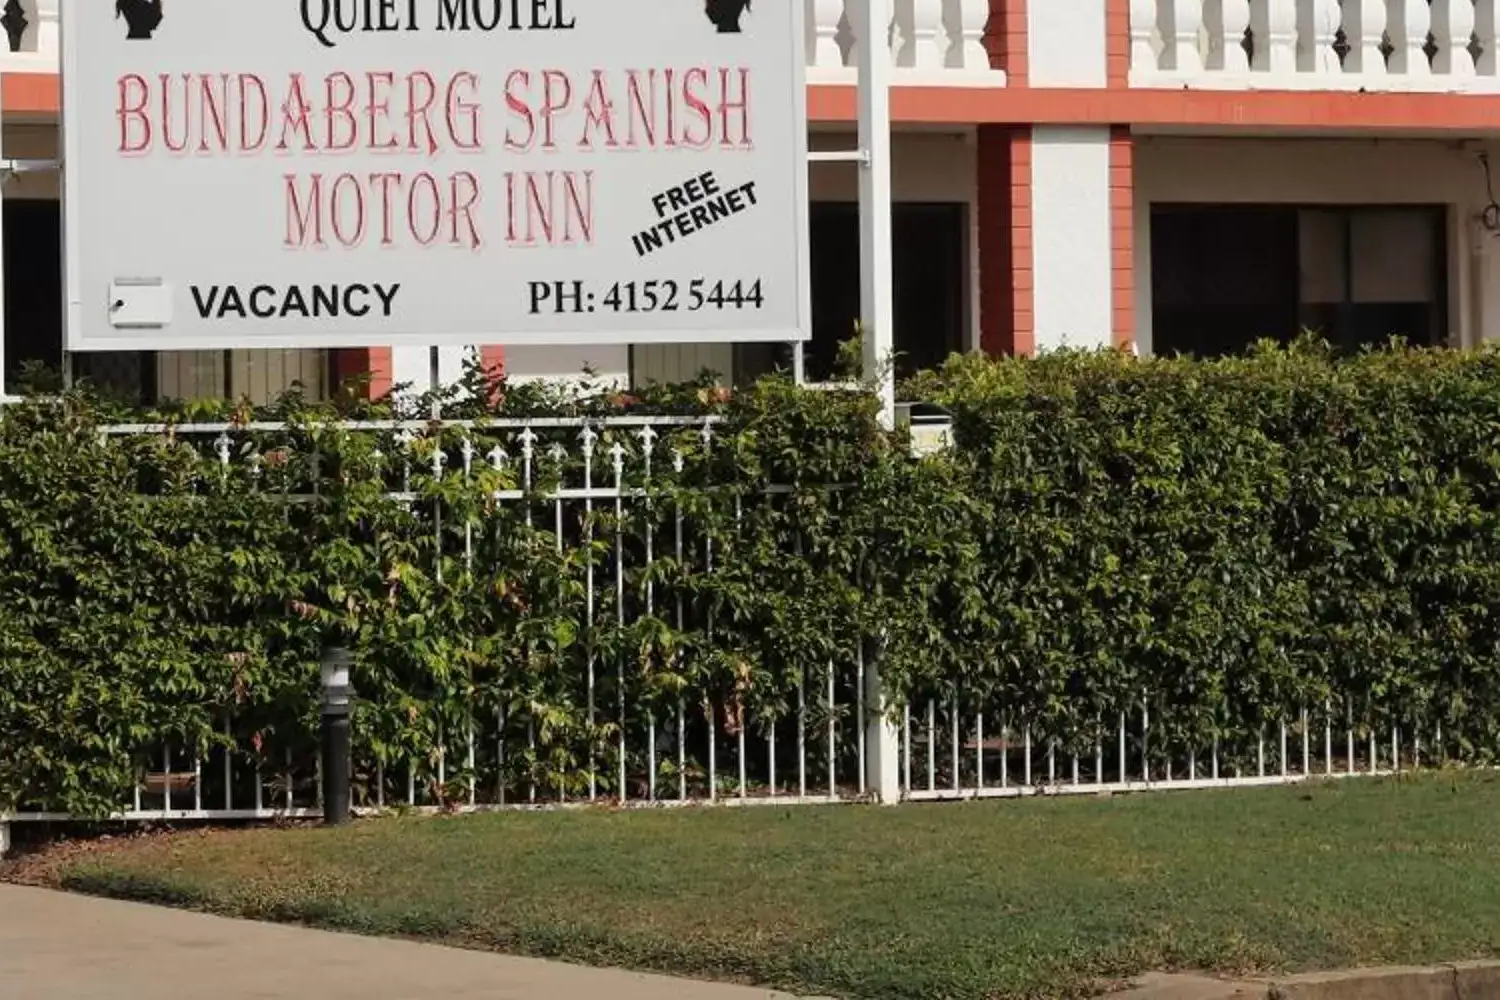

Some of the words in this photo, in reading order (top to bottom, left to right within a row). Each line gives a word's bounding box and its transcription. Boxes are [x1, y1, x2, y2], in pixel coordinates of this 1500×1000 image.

[116, 70, 482, 156] BUNDABERG
[504, 67, 752, 153] SPANISH
[284, 171, 482, 248] MOTOR
[505, 172, 595, 246] INN
[631, 181, 757, 257] INTERNET
[651, 171, 720, 218] FREE
[191, 283, 402, 320] VACANCY
[529, 281, 597, 315] PH:
[603, 280, 680, 313] 4152
[688, 279, 765, 312] 5444
